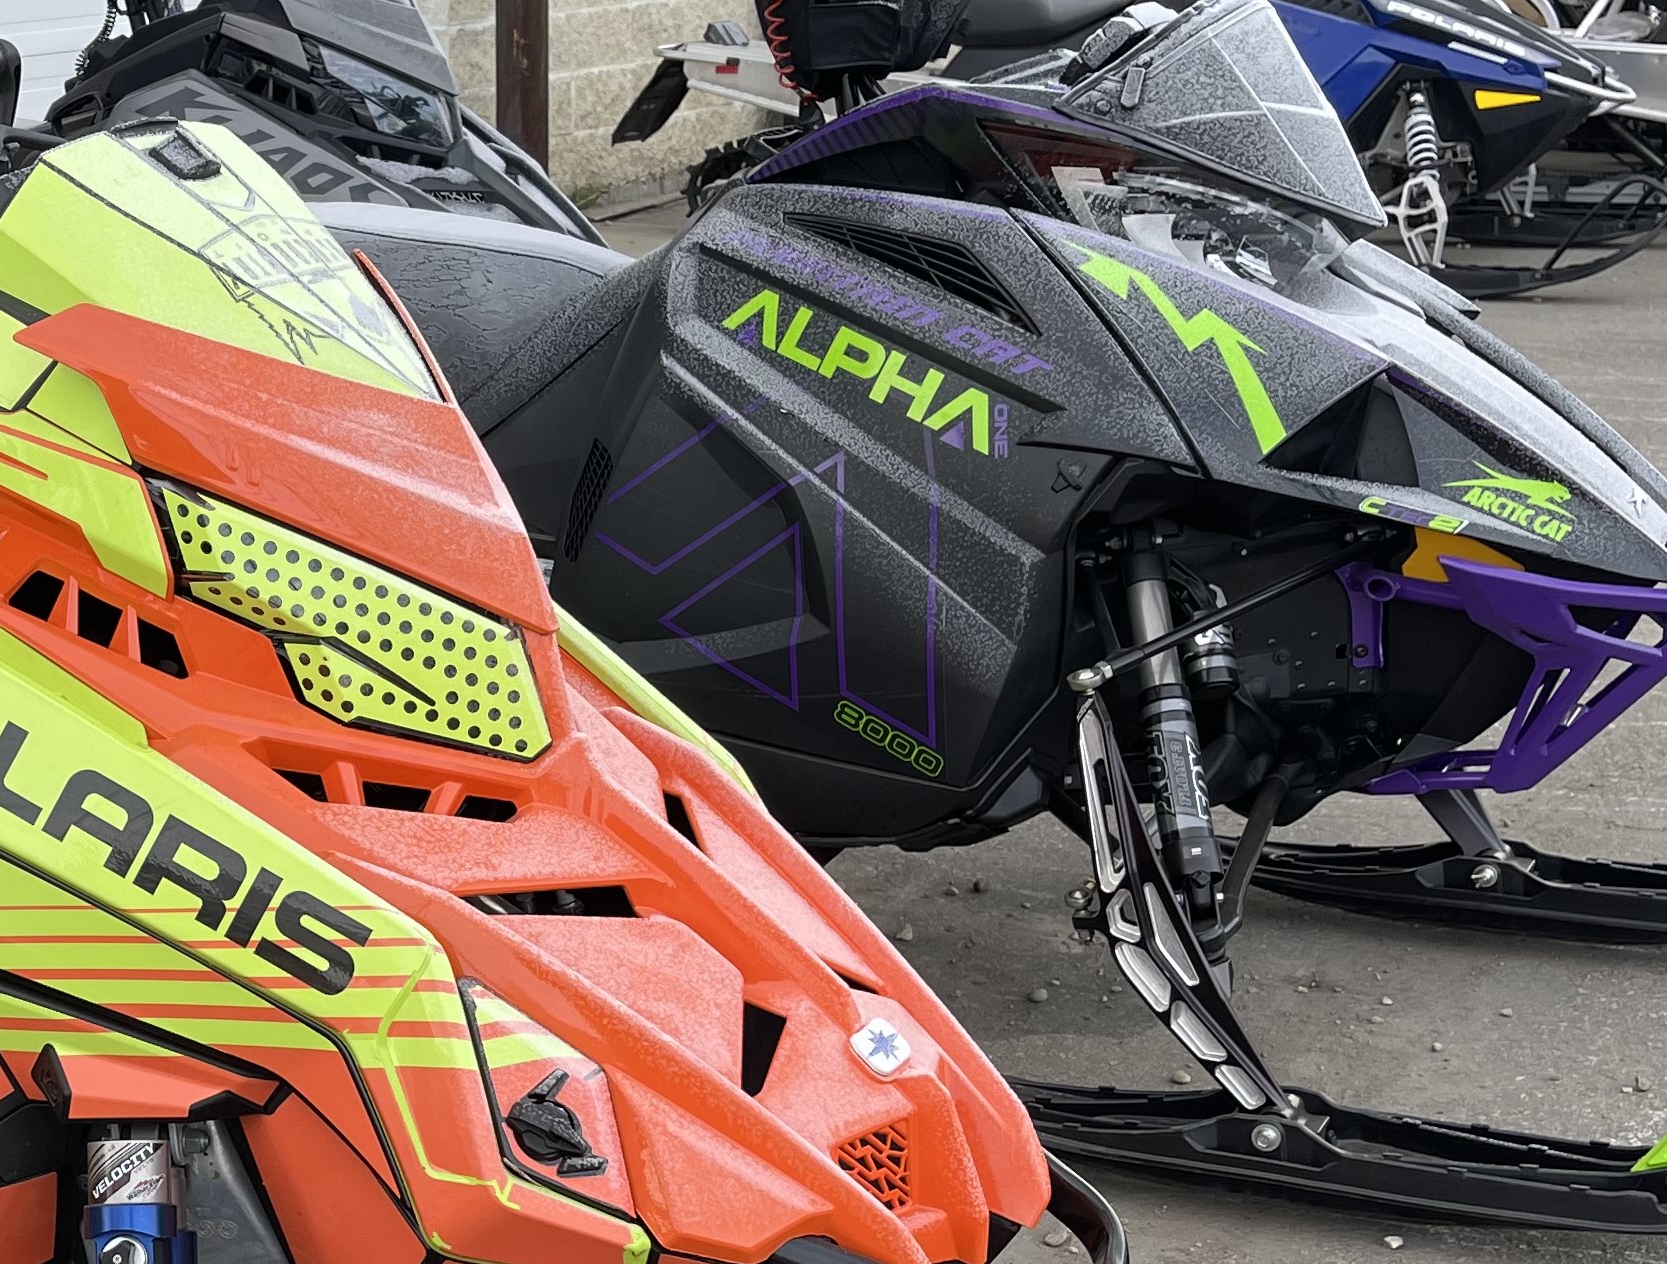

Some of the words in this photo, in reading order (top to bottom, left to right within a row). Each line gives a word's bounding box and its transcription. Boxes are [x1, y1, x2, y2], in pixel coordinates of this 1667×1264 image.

[1387, 1, 1526, 56] POLARIS
[722, 289, 989, 456] ALPHA
[993, 403, 1009, 459] ONE
[943, 325, 1055, 375] CAT
[1462, 486, 1536, 526] ARCTIC
[1533, 515, 1573, 542] CAT
[834, 700, 944, 777] 8000
[92, 1143, 155, 1199] VELOCITY
